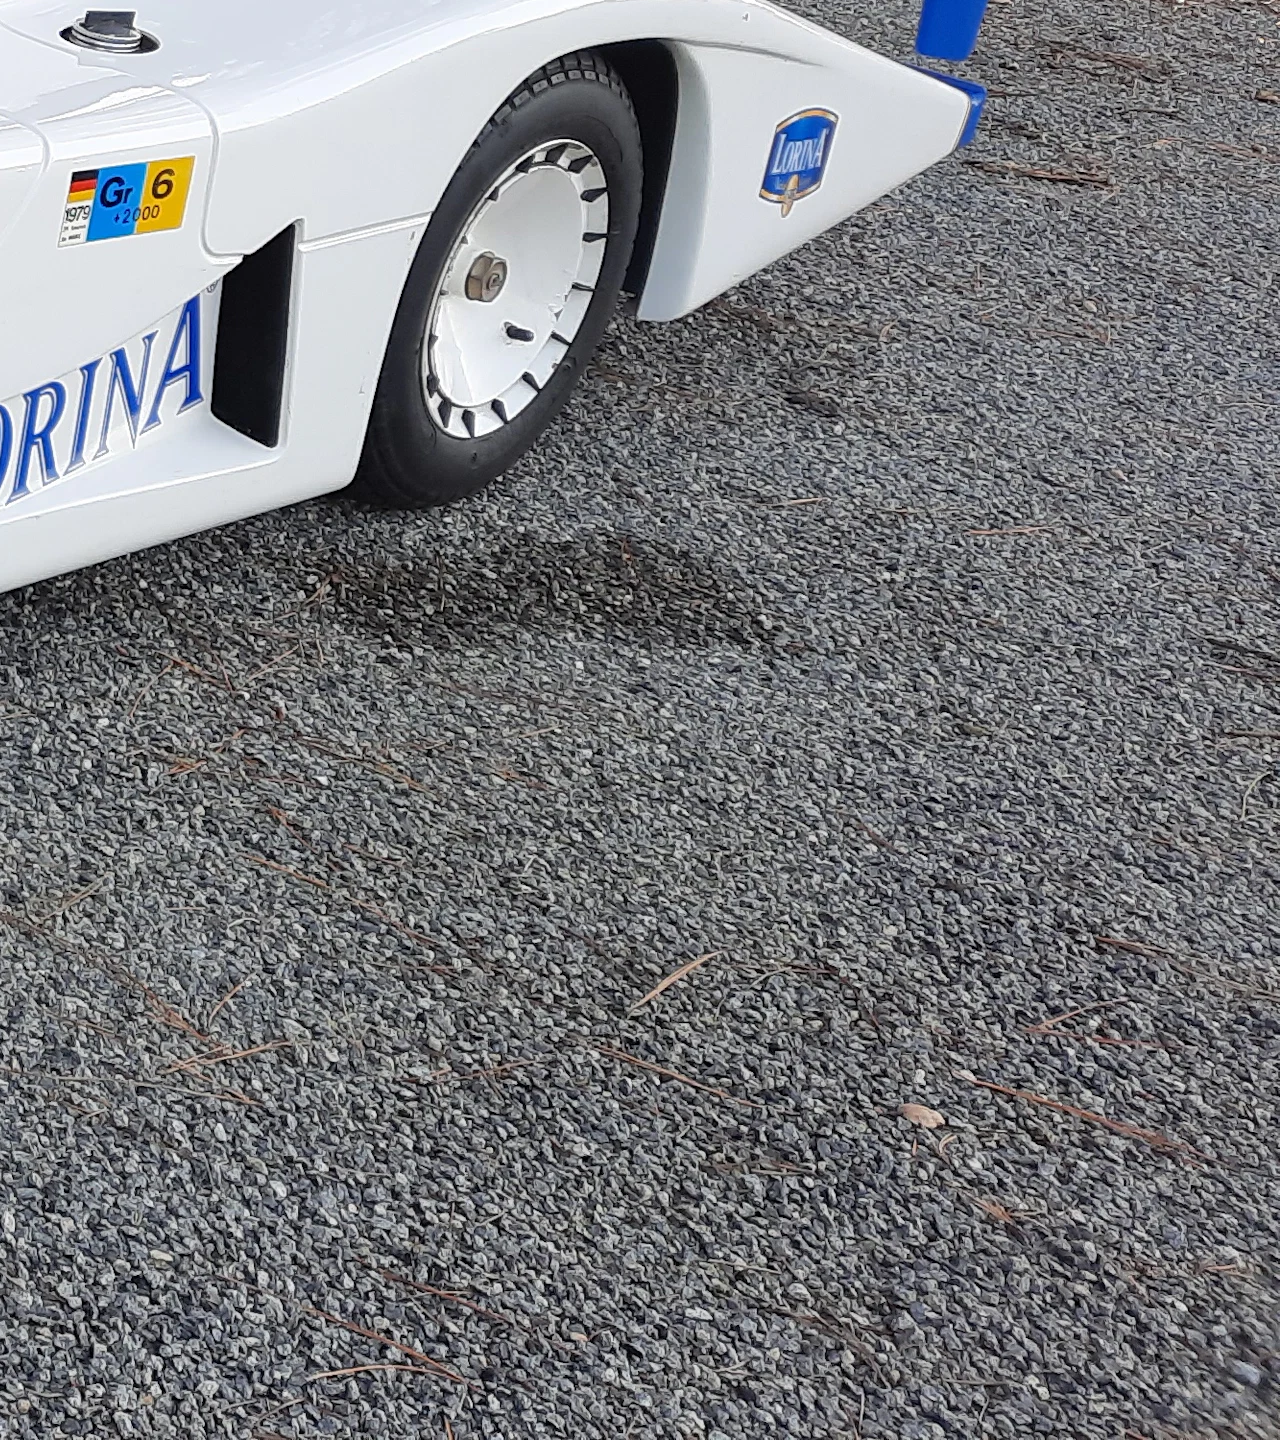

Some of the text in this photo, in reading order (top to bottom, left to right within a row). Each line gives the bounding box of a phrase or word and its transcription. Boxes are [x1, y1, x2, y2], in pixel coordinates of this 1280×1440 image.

[771, 128, 827, 175] LORINA
[100, 168, 175, 208] Gr 6
[65, 205, 90, 223] 1979
